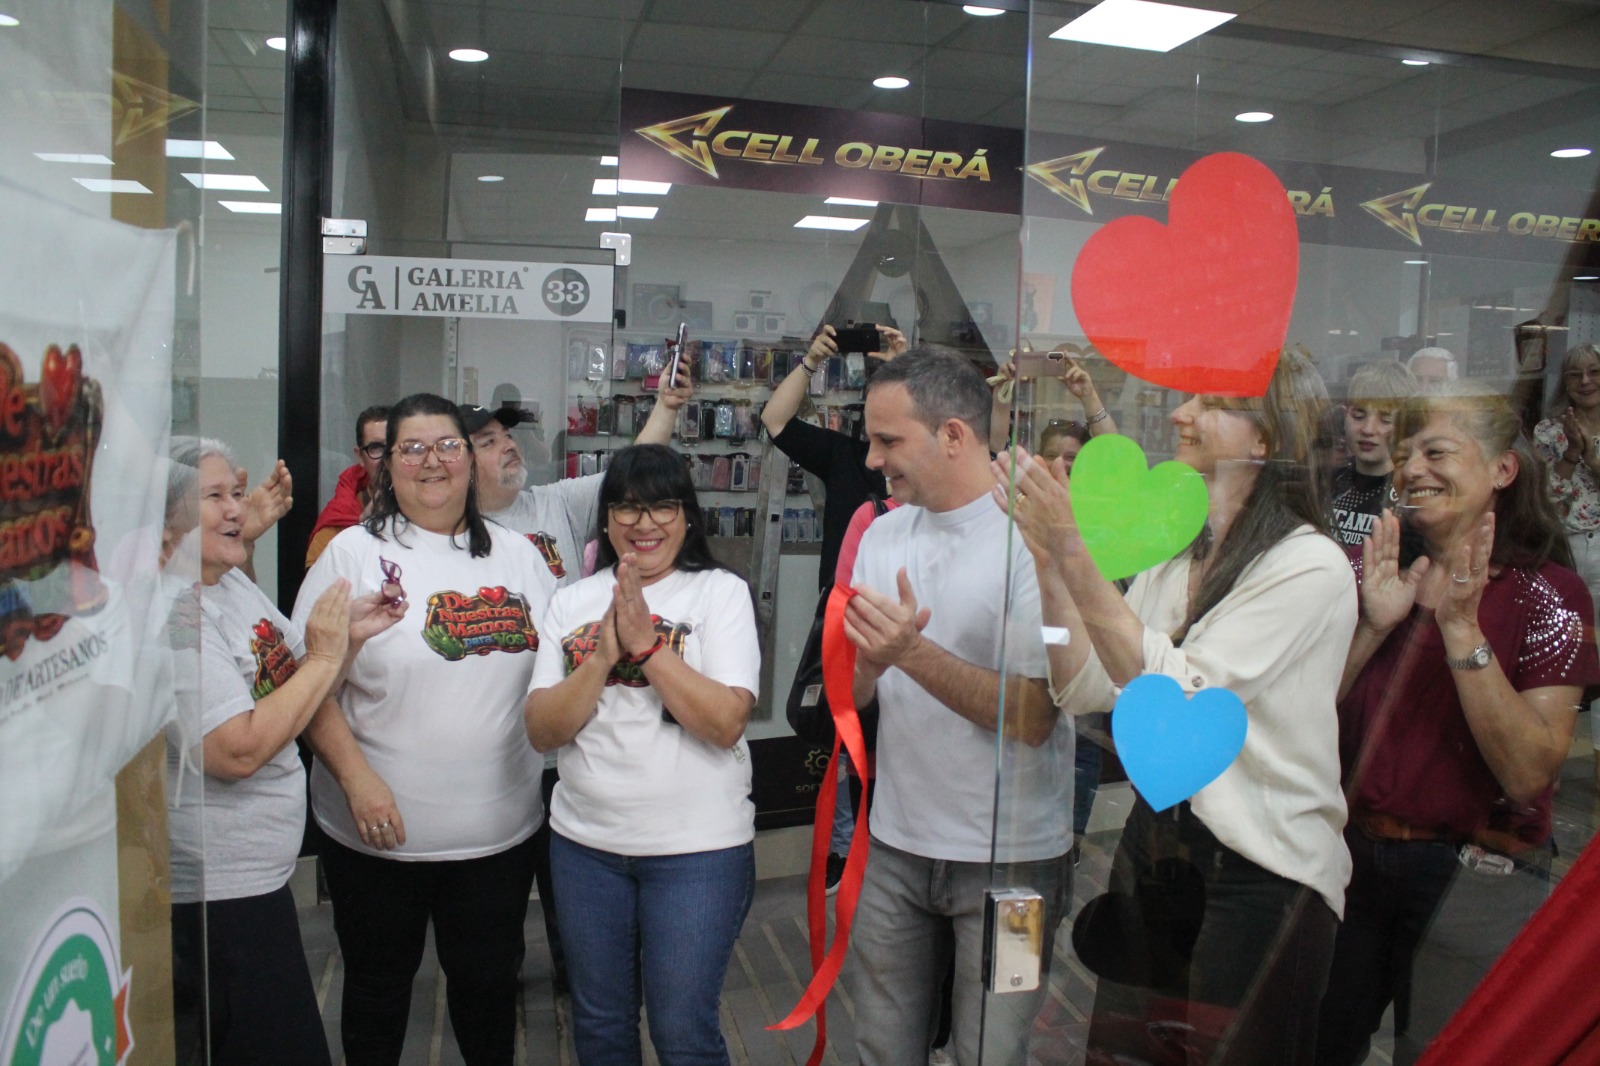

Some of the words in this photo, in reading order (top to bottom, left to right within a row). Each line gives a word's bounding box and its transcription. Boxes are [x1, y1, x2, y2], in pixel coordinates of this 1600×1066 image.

[711, 130, 824, 165] CELL
[834, 148, 991, 182] OBERÁ
[1416, 203, 1500, 233] CELL
[1507, 212, 1600, 242] OBER
[407, 266, 525, 290] GALERIA
[411, 292, 520, 315] AMELIA
[546, 280, 585, 304] 33
[0, 446, 85, 500] estras
[444, 594, 472, 609] De
[438, 606, 522, 622] Nuestras
[446, 620, 517, 637] Manos
[464, 636, 493, 647] para
[493, 632, 525, 647] Vos
